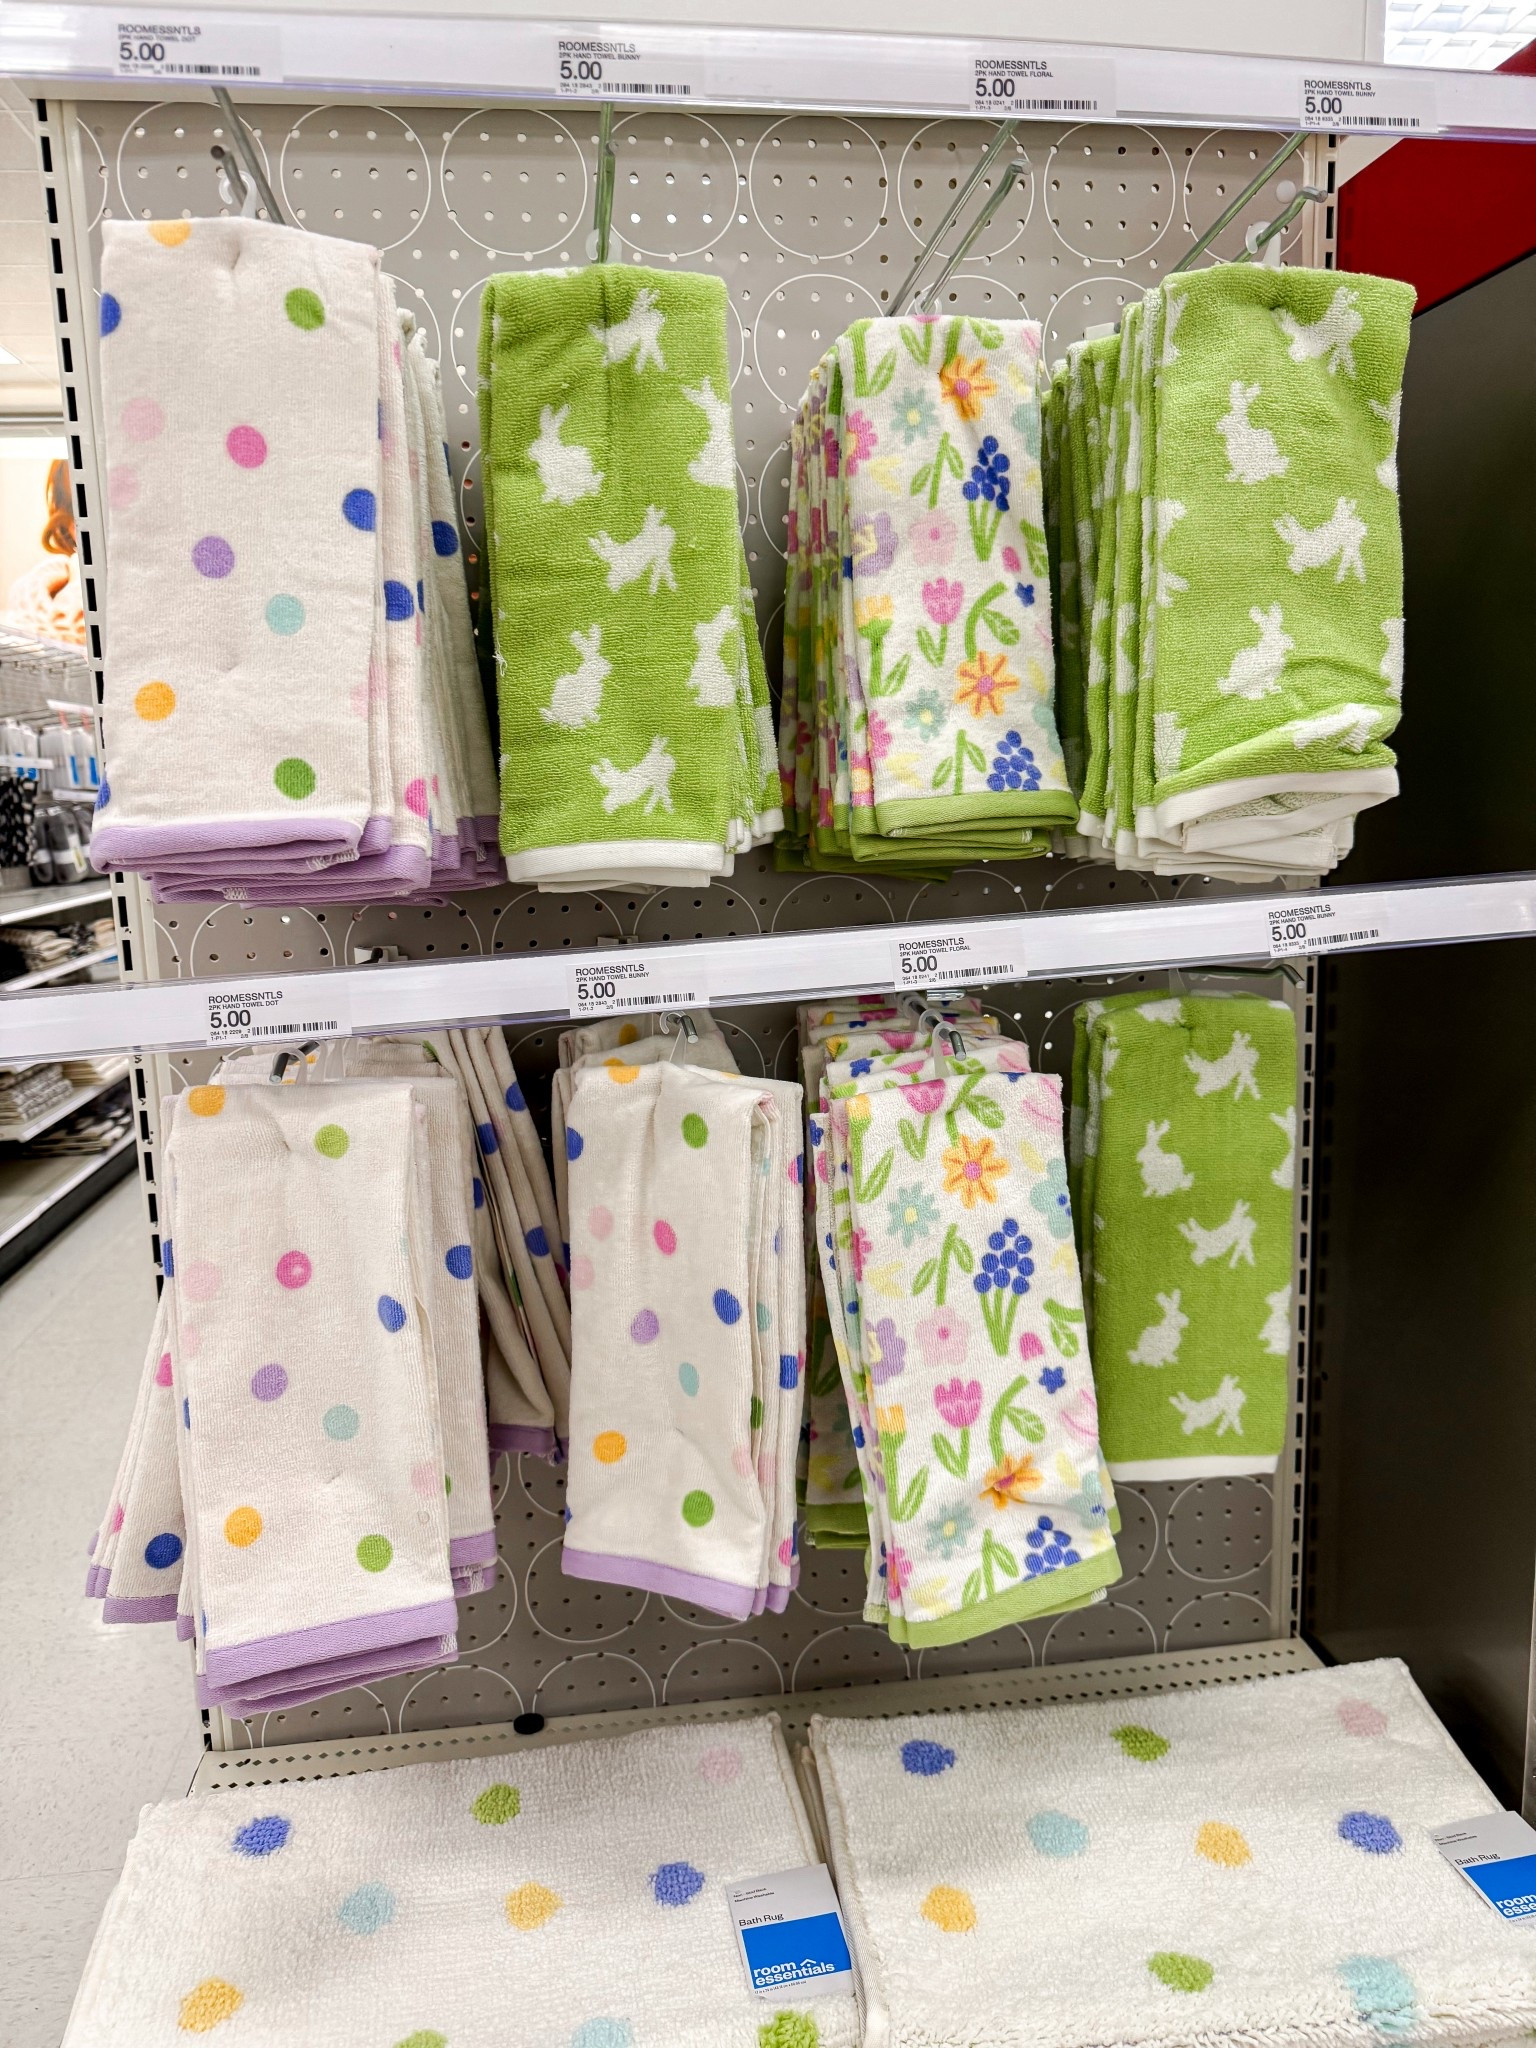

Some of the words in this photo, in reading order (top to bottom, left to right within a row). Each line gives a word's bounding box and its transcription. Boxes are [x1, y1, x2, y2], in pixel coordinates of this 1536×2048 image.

[118, 24, 201, 35] ROOMESSNTLS
[120, 43, 165, 60] 5.00
[559, 42, 636, 52] ROOMESSNTLS
[560, 61, 602, 80] 5.00
[975, 60, 1047, 69] ROOMESSNTLS
[976, 78, 1015, 97] 5.00
[1304, 80, 1371, 90] ROOMESSNTLS
[1305, 97, 1342, 114] 5.00
[1269, 905, 1330, 919] ROOMESSNTLS
[1272, 923, 1306, 941] 5.00
[899, 938, 964, 951] ROOMESSNTLS
[576, 964, 644, 976] ROOMESSNTLS
[902, 956, 937, 973] 5.00
[209, 991, 283, 1004] ROOMESSNTLS
[578, 982, 615, 999] 5.00
[210, 1010, 251, 1028] 5.00
[1455, 1857, 1479, 1865] Bath
[739, 1916, 762, 1926] Bath
[754, 1962, 796, 1977] room
[755, 1962, 835, 1986] essentials
